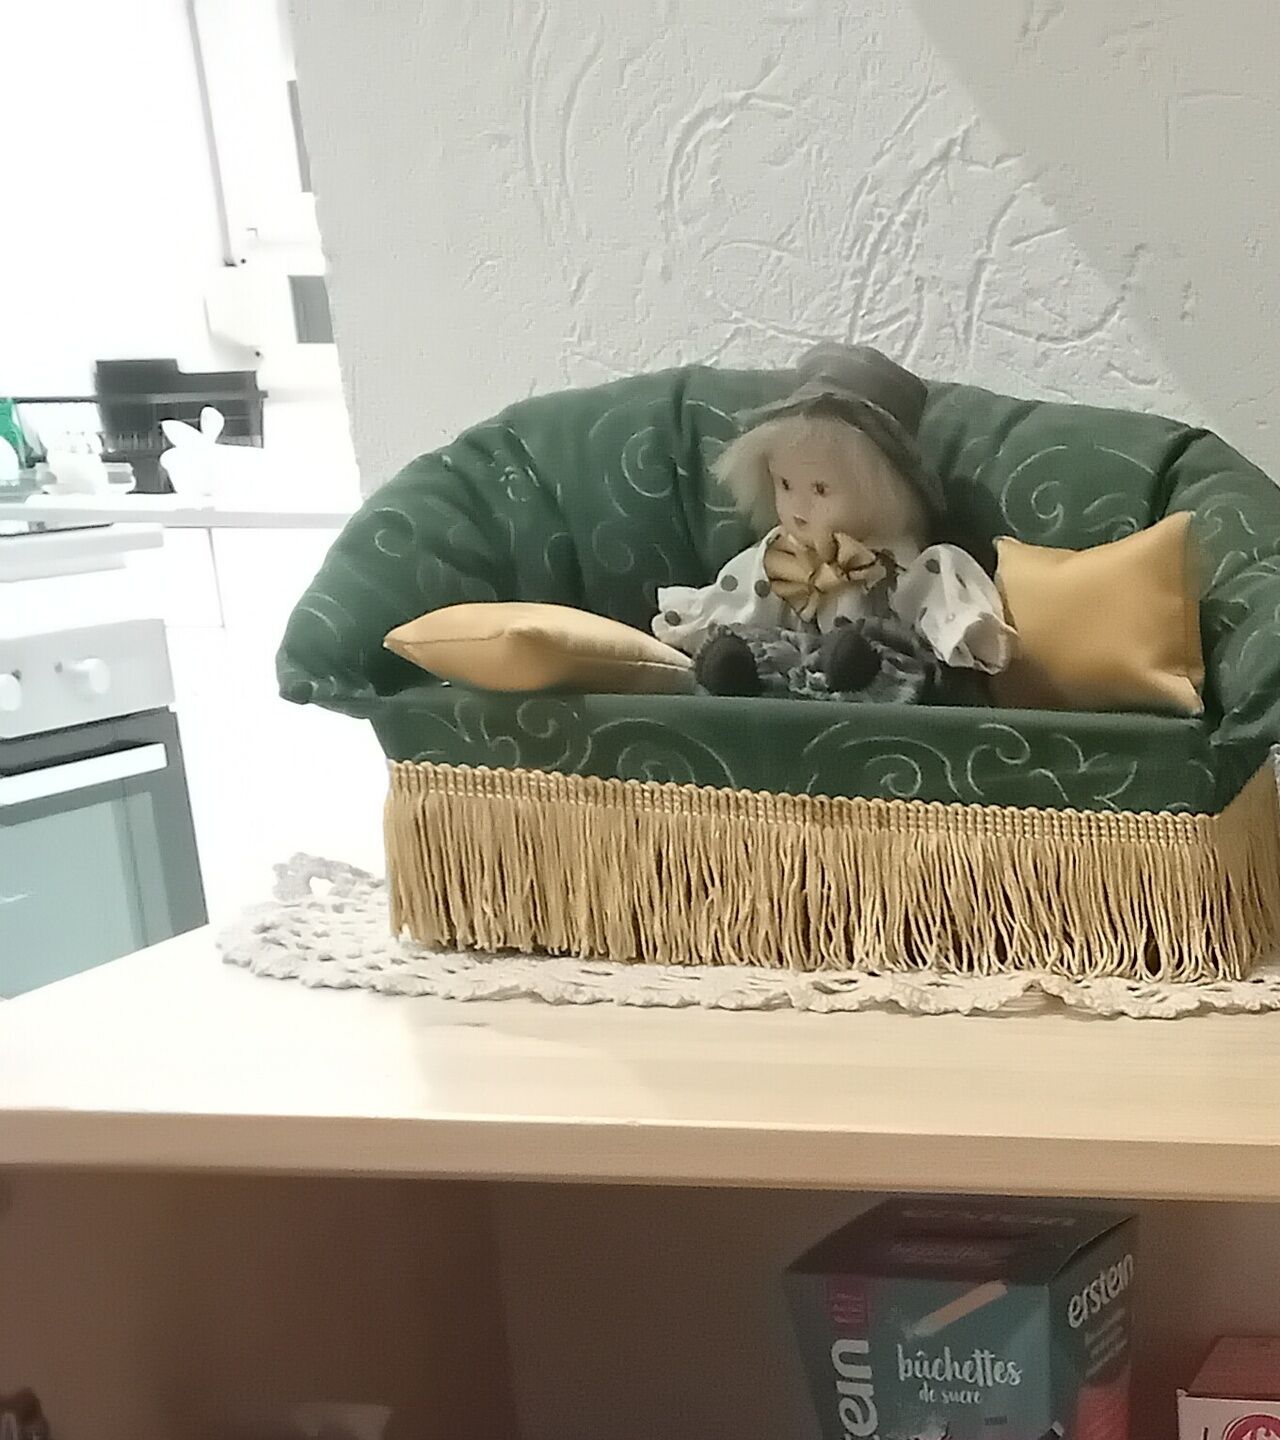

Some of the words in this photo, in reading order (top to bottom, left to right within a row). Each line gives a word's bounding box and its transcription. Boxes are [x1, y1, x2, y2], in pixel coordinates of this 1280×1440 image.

[1068, 1254, 1135, 1328] erstein
[897, 1343, 1022, 1387] bûchettes
[919, 1381, 936, 1402] de
[941, 1390, 982, 1404] sucre
